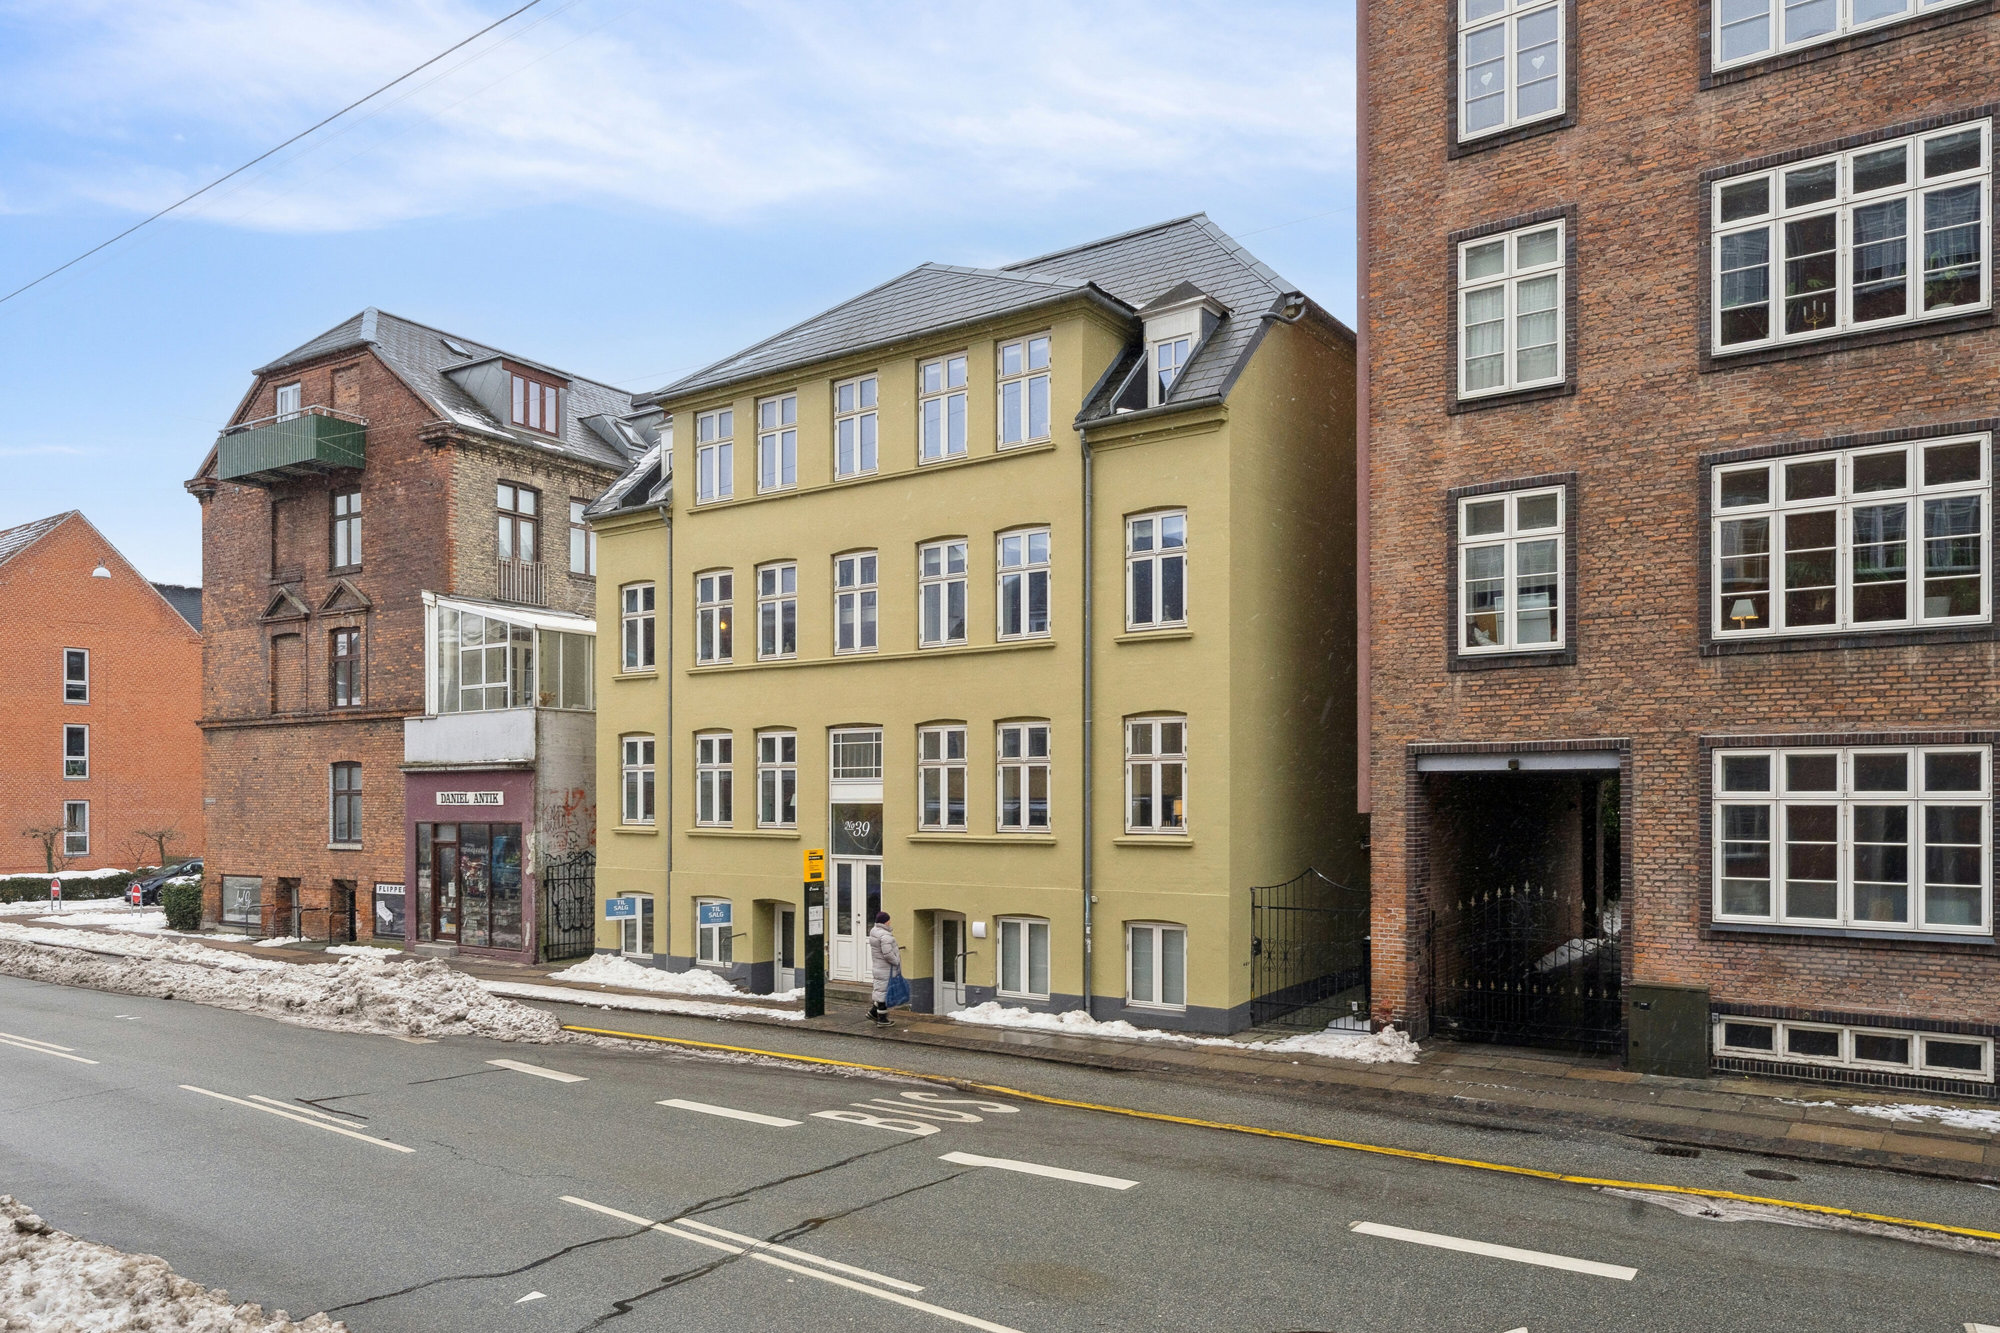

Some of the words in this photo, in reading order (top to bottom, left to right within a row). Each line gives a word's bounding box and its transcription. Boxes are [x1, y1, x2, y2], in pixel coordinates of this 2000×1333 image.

[440, 793, 469, 804] DANIEL
[473, 793, 499, 804] ANTIK
[853, 820, 870, 837] 39
[809, 1091, 1021, 1136] BUS
